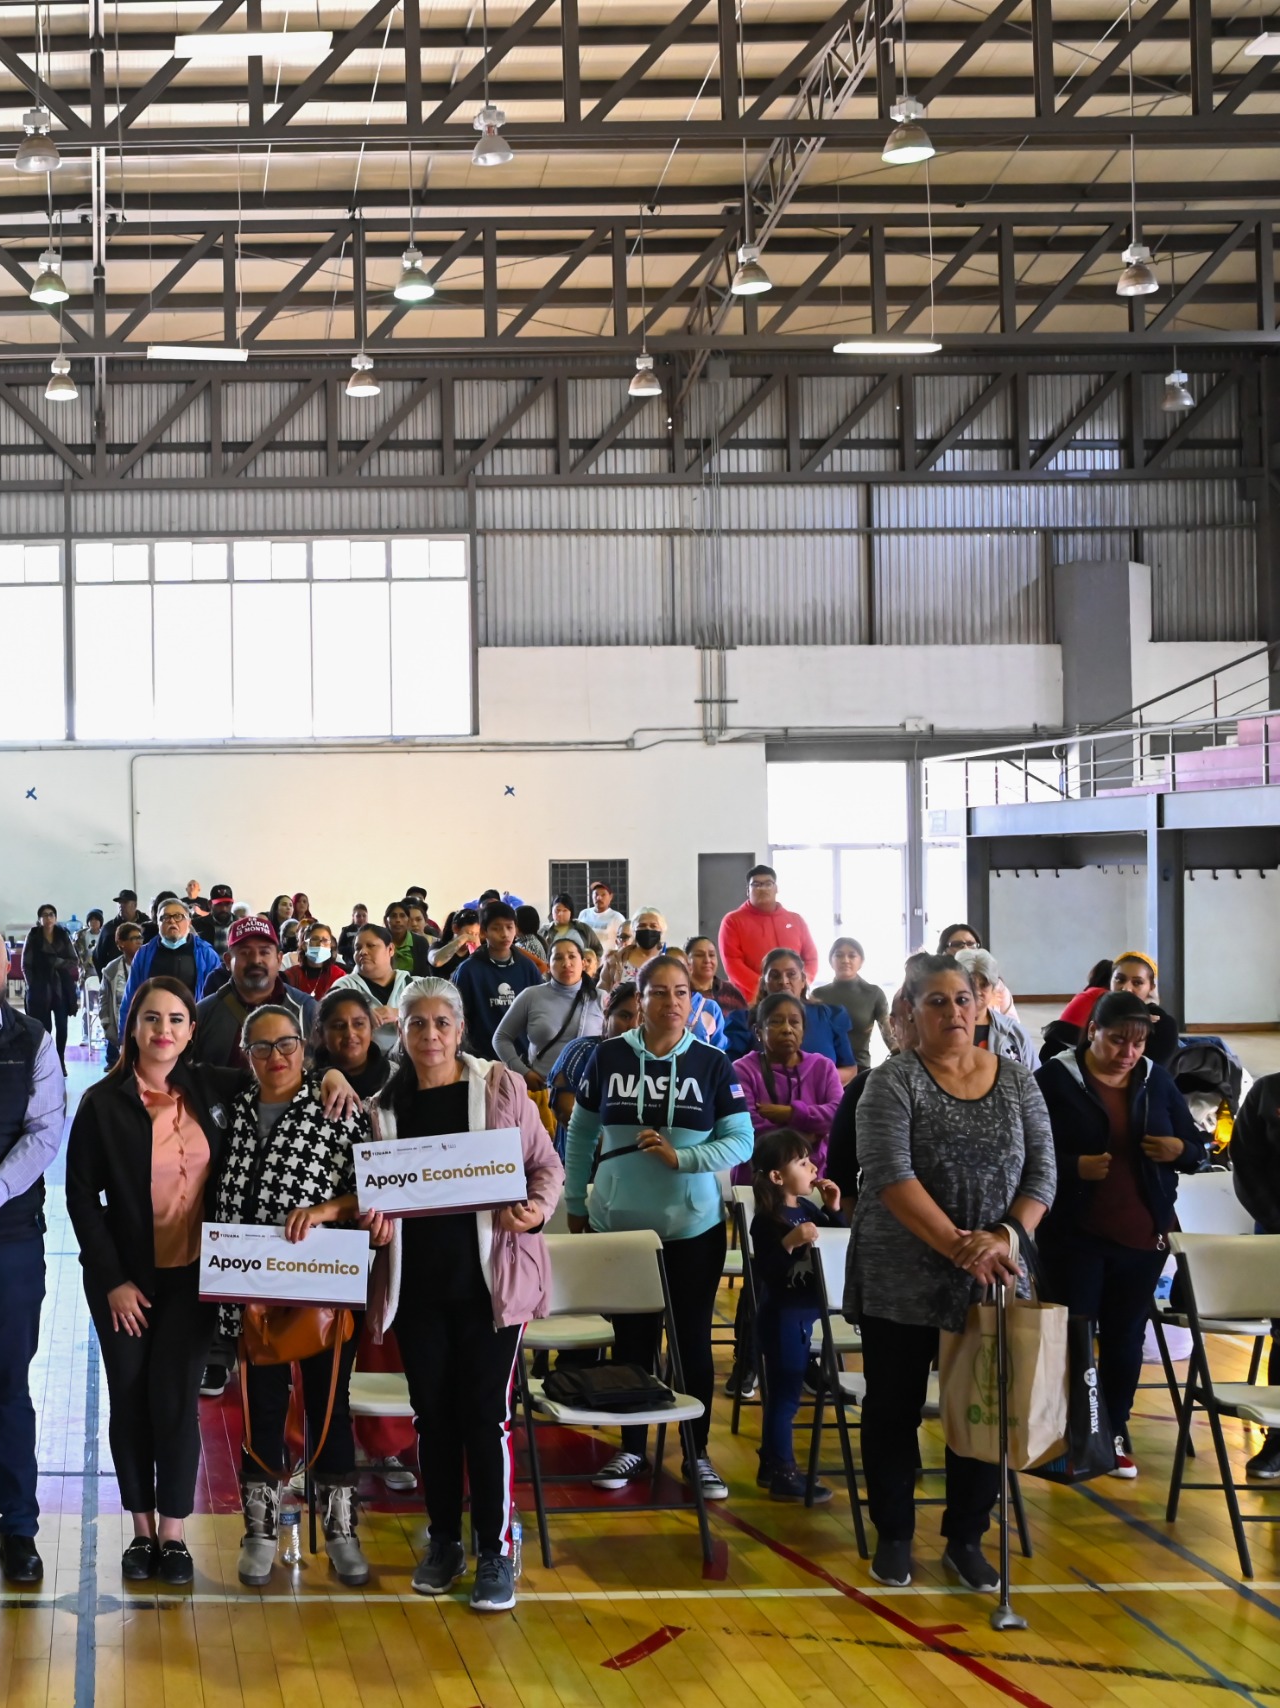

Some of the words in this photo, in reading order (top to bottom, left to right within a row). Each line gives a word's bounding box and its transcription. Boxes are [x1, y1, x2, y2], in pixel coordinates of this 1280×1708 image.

[236, 920, 269, 931] CLAUDIA
[607, 1072, 703, 1103] NASA
[365, 1172, 418, 1189] Apoyo
[422, 1160, 516, 1182] Económico
[208, 1255, 262, 1272] Apoyo
[266, 1258, 360, 1275] Económico
